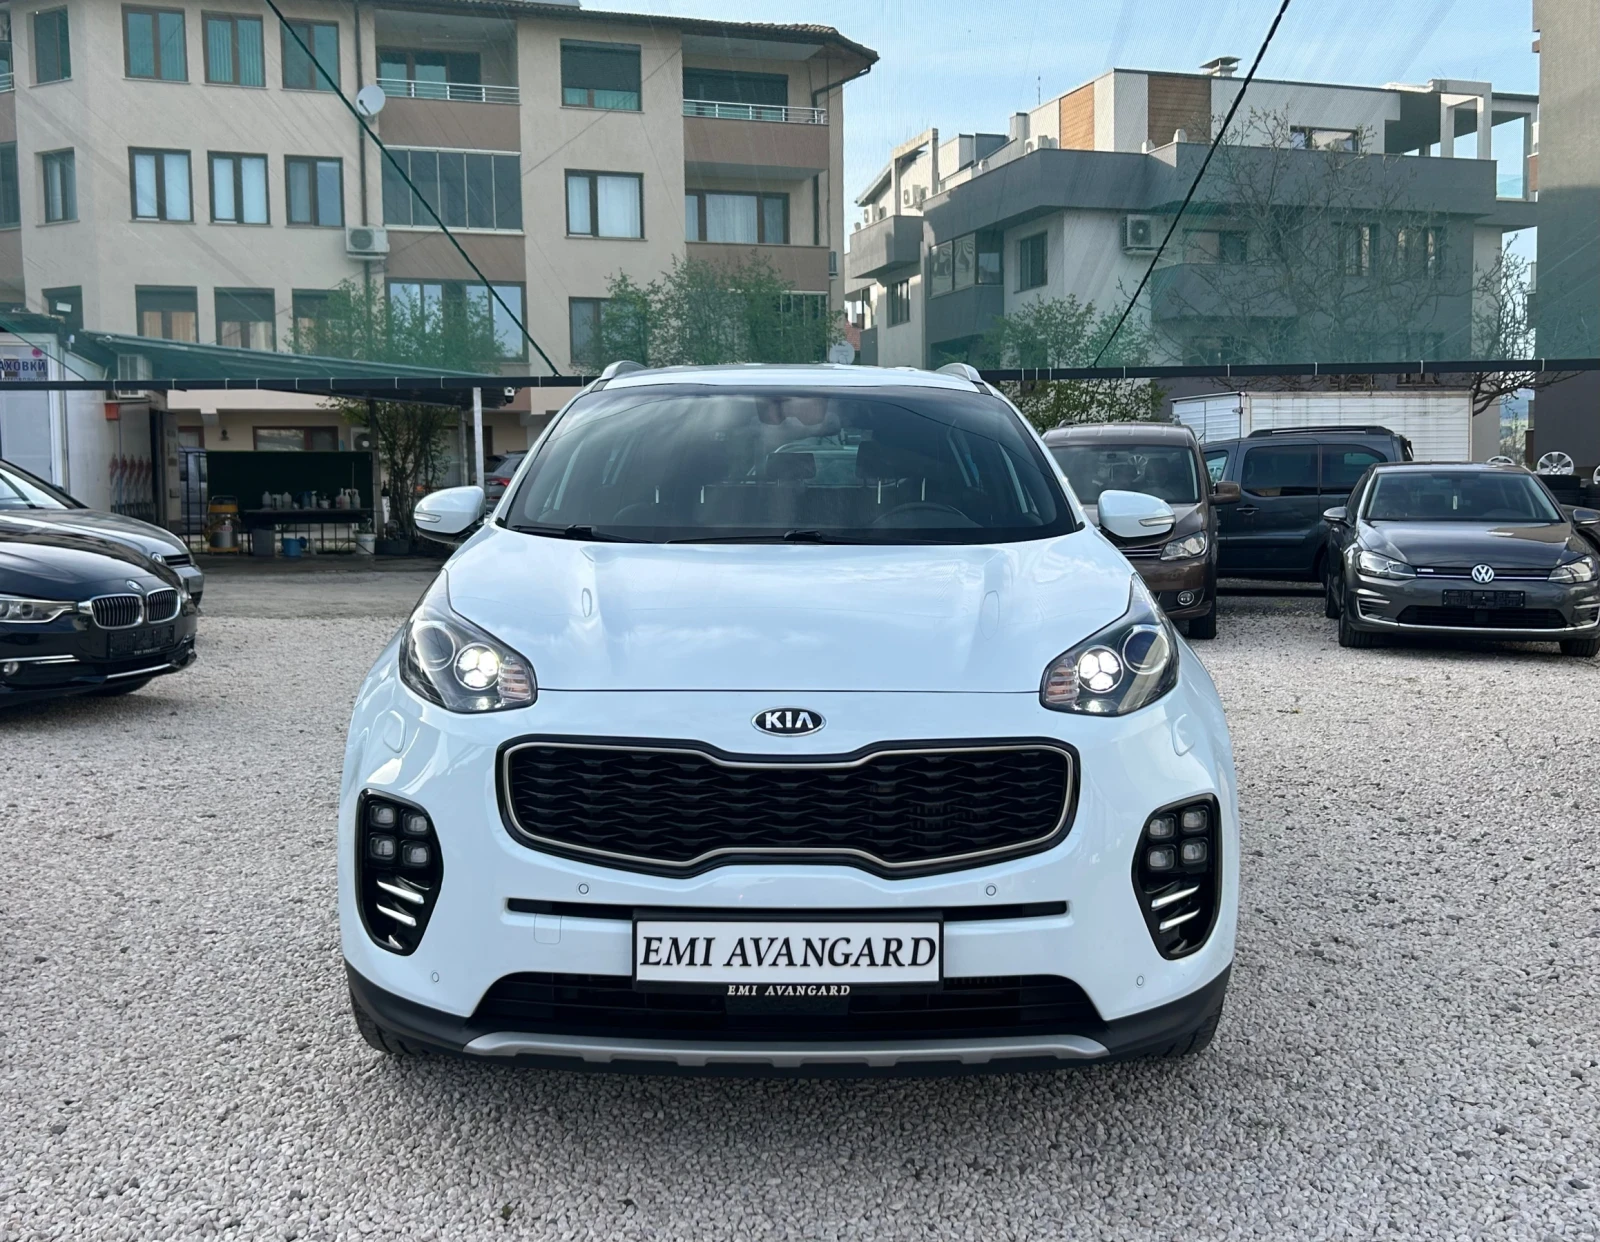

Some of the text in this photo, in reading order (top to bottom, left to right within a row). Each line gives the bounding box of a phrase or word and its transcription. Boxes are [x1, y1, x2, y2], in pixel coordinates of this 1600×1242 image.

[765, 711, 814, 729] KIA
[640, 936, 936, 967] EMI AVANGARD
[727, 985, 850, 996] EMI AVANGARD
